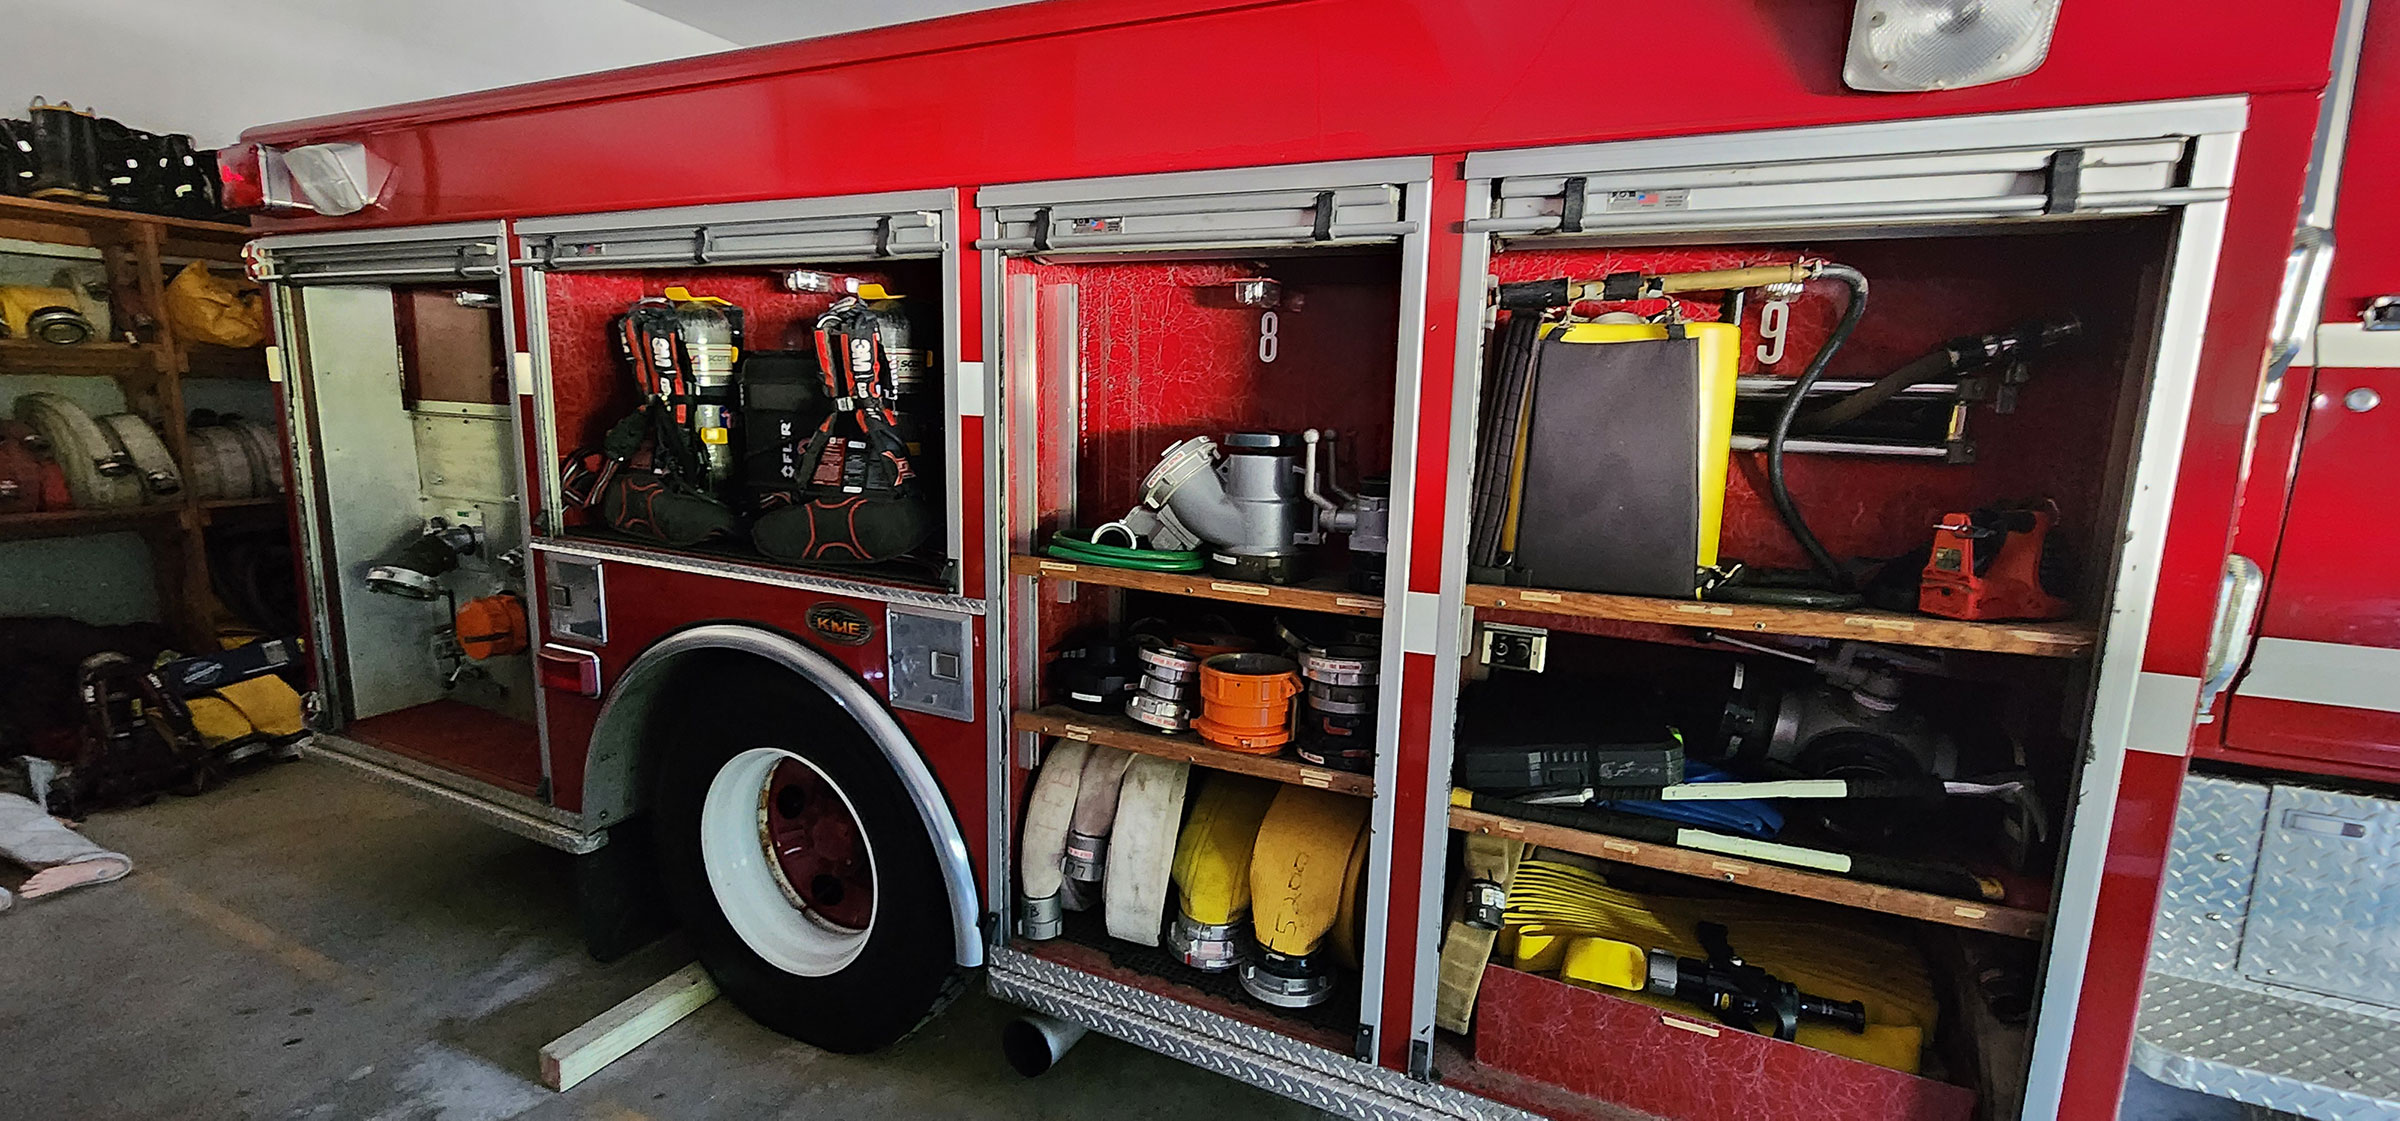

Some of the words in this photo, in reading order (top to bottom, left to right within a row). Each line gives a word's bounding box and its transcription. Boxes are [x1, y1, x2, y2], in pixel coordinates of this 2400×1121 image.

[1260, 311, 1278, 362] 8
[1757, 301, 1789, 364] 9
[780, 422, 792, 464] FLR
[817, 617, 861, 636] KME
